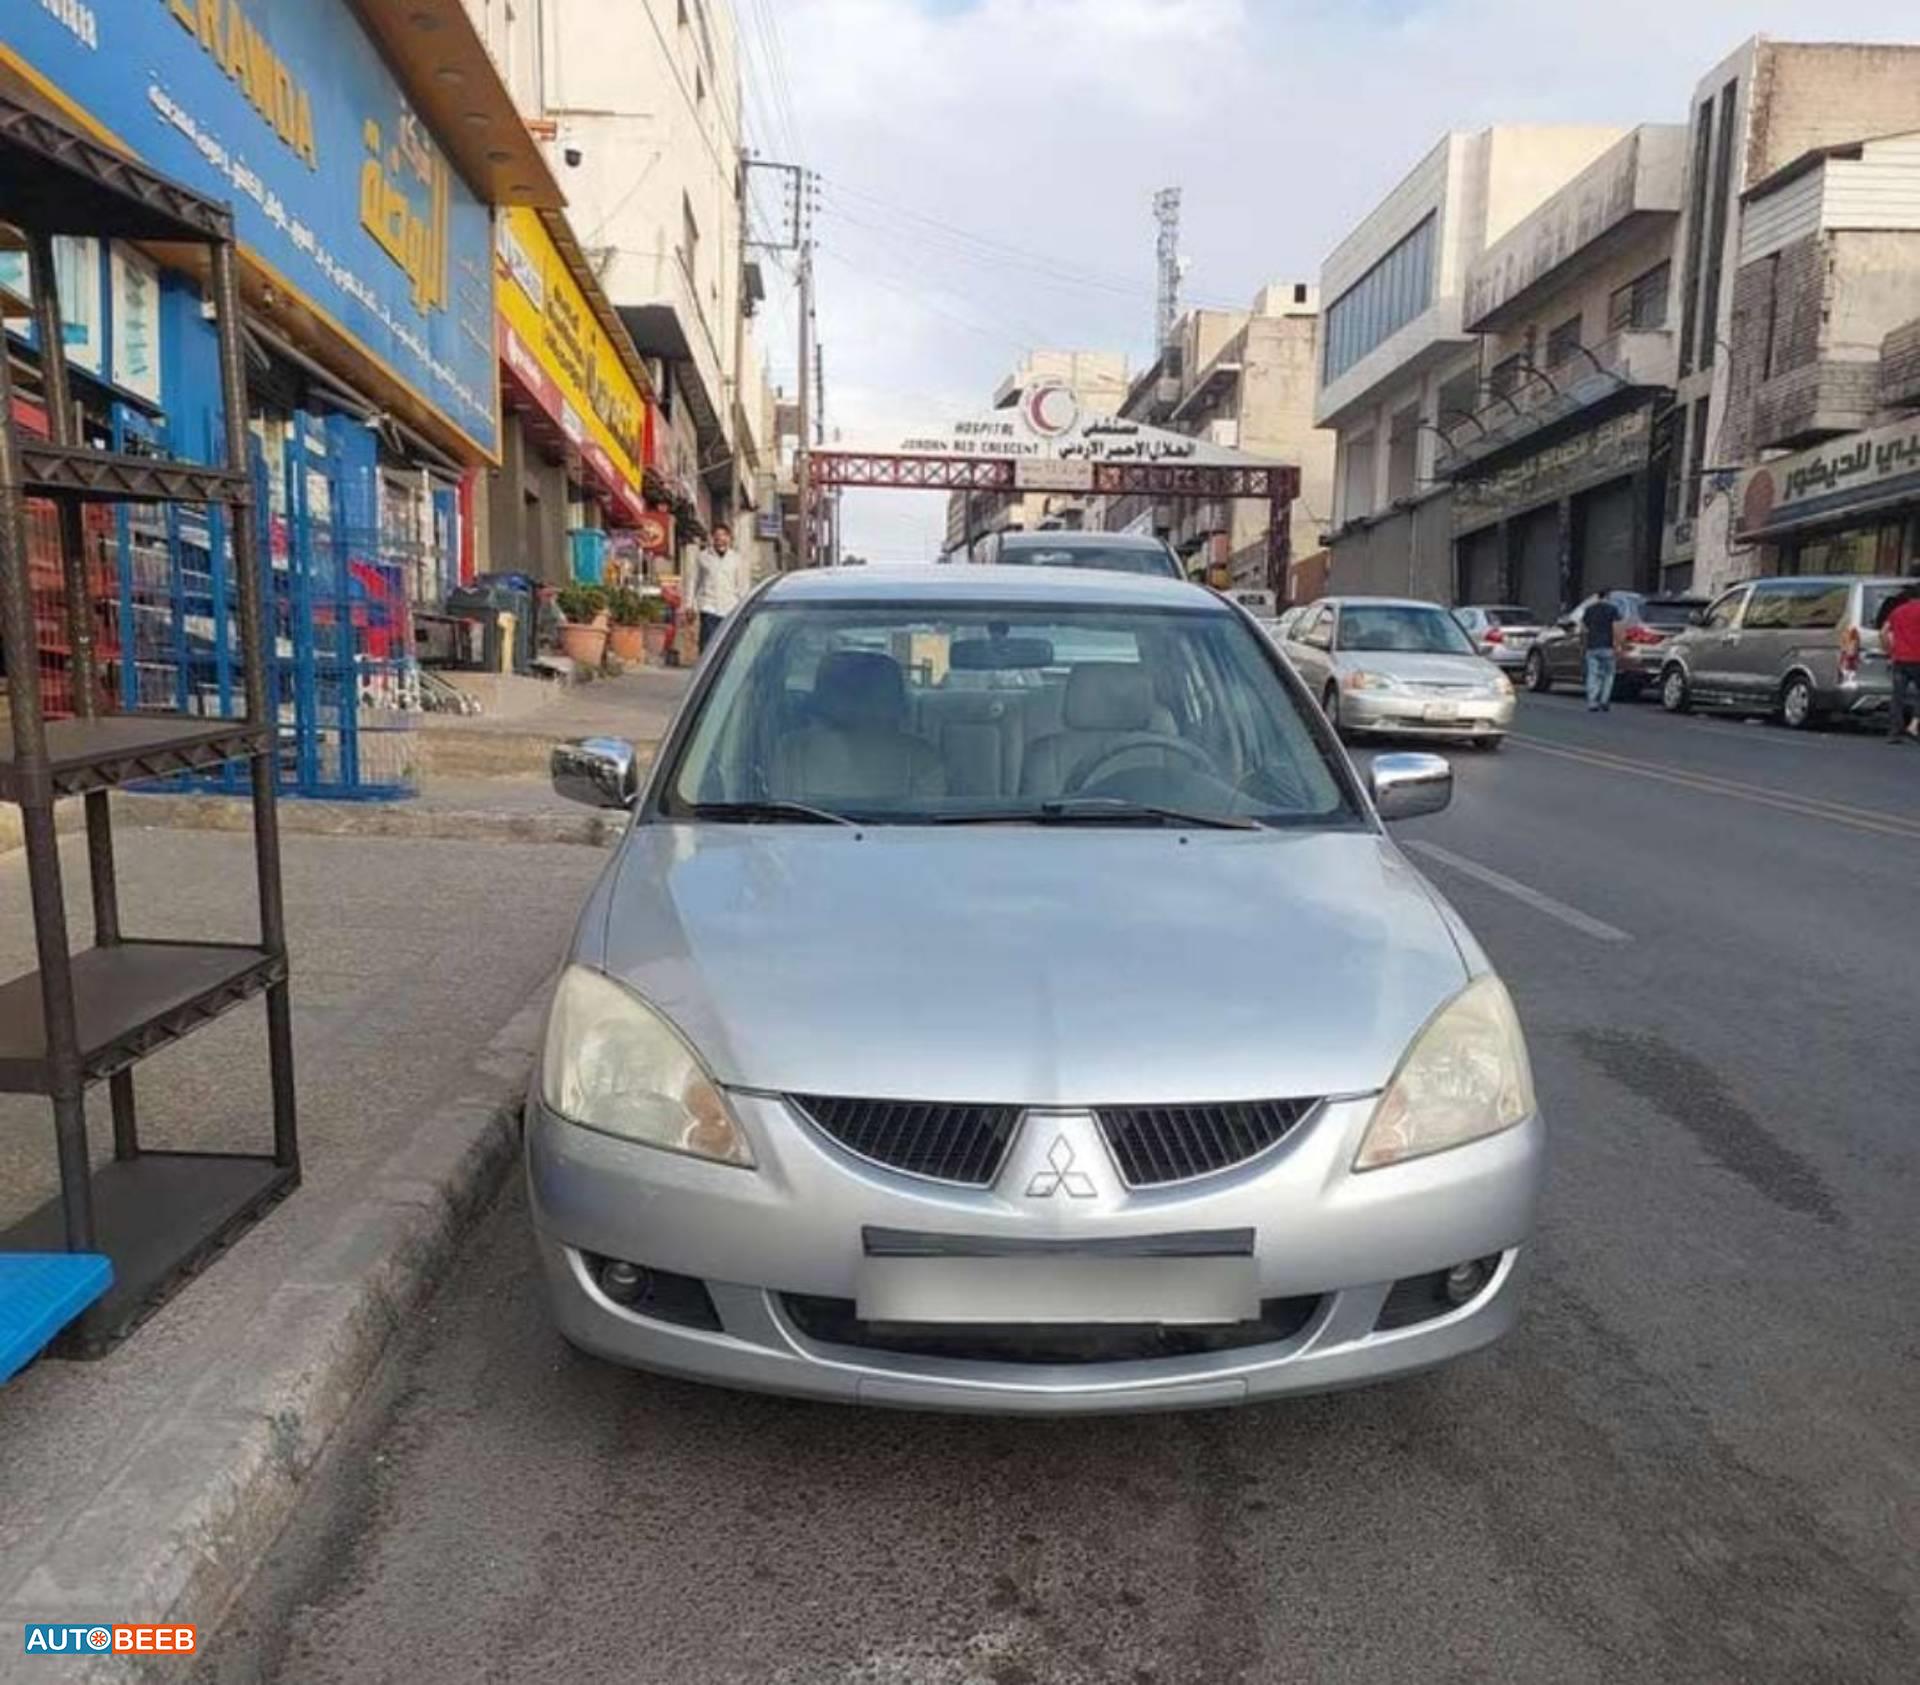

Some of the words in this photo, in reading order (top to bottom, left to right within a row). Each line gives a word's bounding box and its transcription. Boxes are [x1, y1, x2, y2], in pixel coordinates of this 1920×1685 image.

[954, 422, 1015, 436] HOSPITAL
[901, 437, 948, 451] JORDAN
[953, 440, 975, 453] RED
[980, 440, 1039, 455] CRESCENT
[1783, 440, 1873, 500] للديكور
